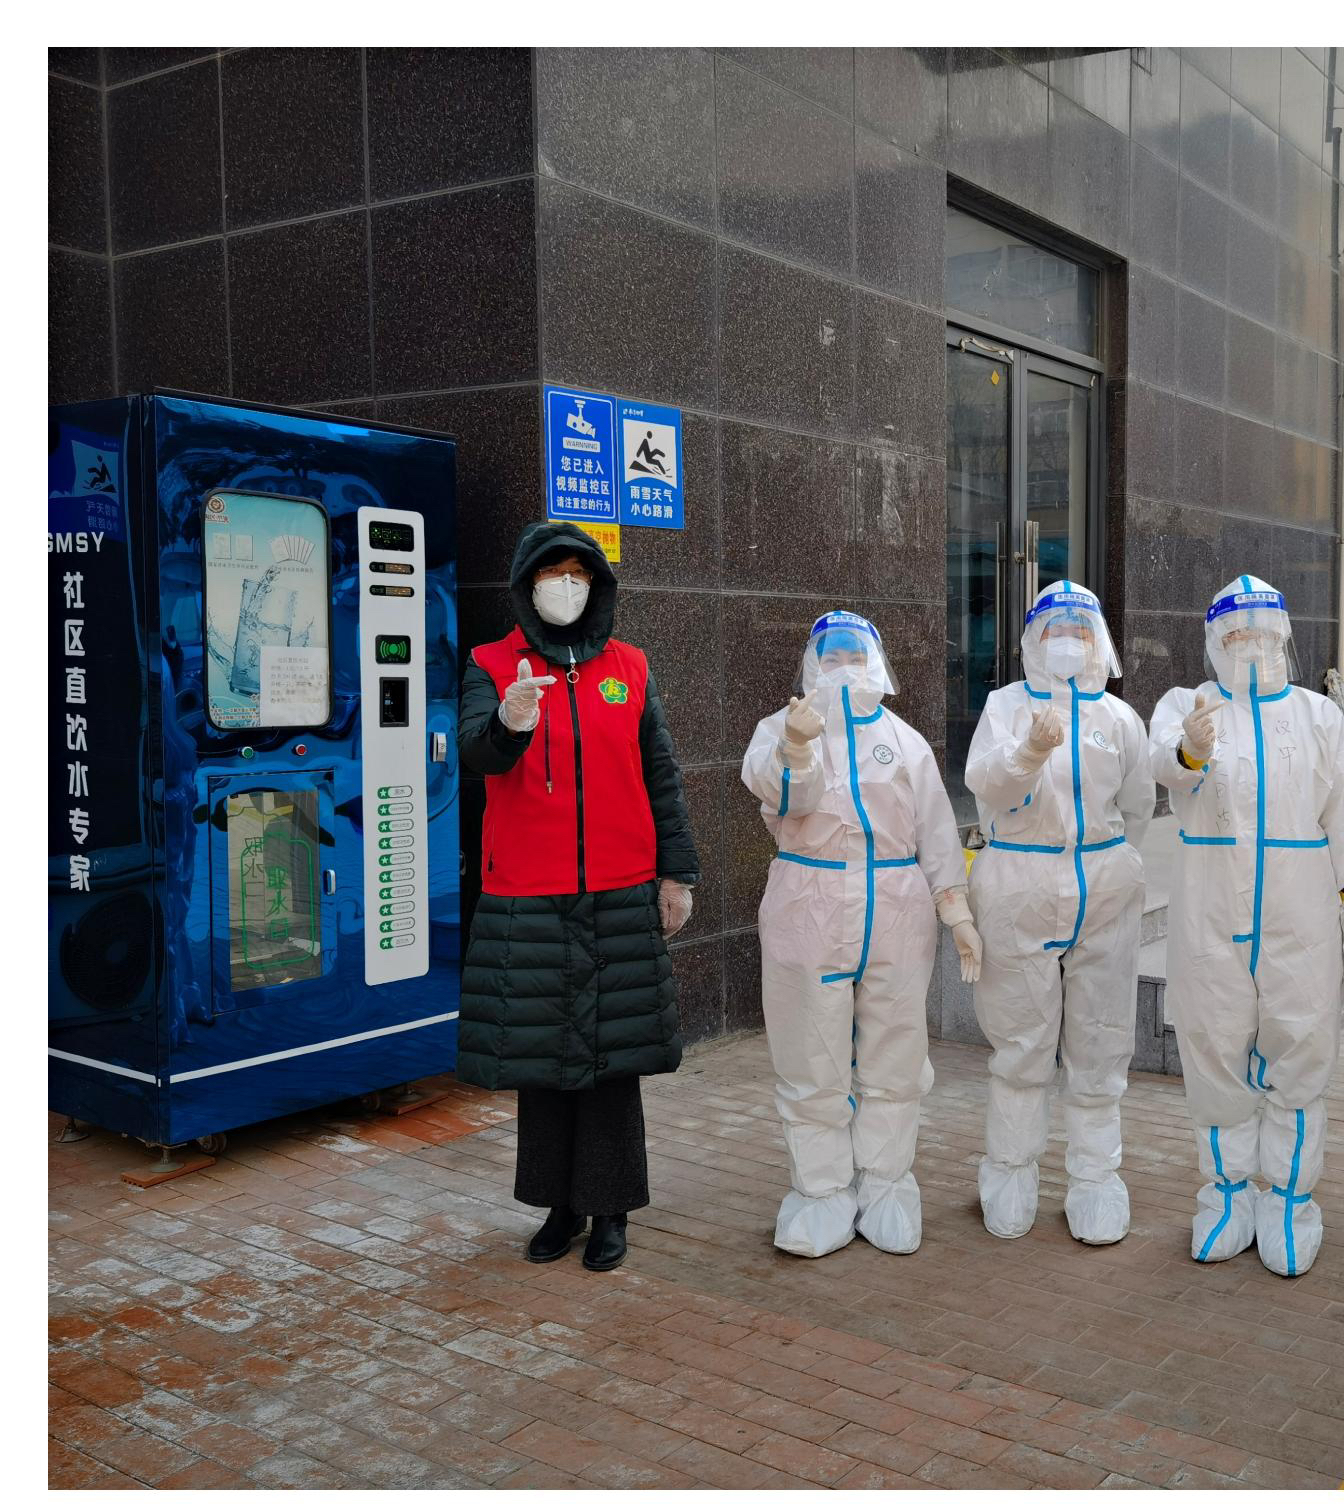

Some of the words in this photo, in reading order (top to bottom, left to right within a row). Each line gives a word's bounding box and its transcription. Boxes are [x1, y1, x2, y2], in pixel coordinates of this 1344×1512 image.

[561, 456, 604, 475] 您已进入
[556, 476, 610, 495] 视频监控区
[630, 486, 673, 502] 雨雪天气
[556, 496, 611, 512] 请注重您的行为
[630, 503, 673, 519] 小心路滑
[64, 571, 90, 892] 社区直饮水专家
